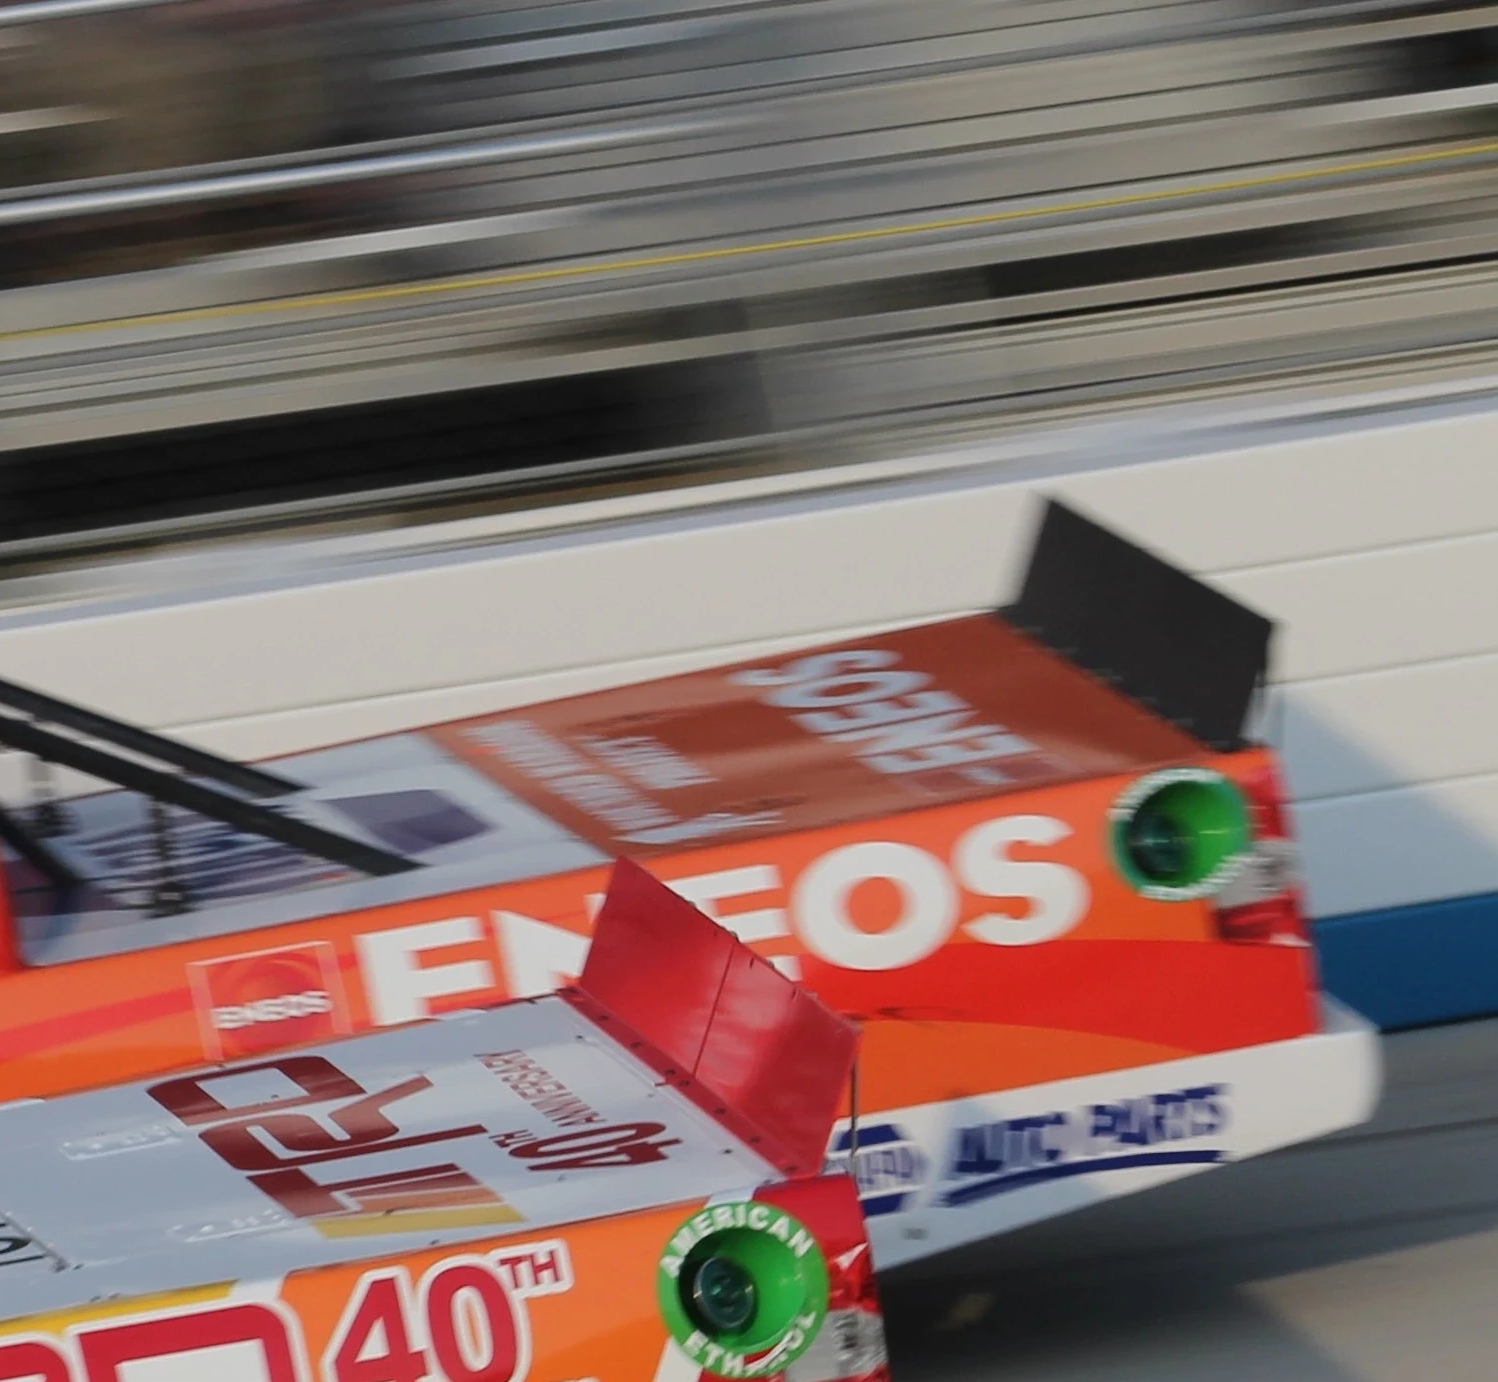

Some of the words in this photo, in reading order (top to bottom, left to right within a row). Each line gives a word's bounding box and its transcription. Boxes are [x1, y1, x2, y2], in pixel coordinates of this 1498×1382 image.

[725, 648, 1041, 778] ENEOS
[210, 989, 334, 1031] ENEOS
[146, 1054, 493, 1218] TRD
[500, 1244, 565, 1292] TH
[659, 1206, 816, 1280] AMERICAN
